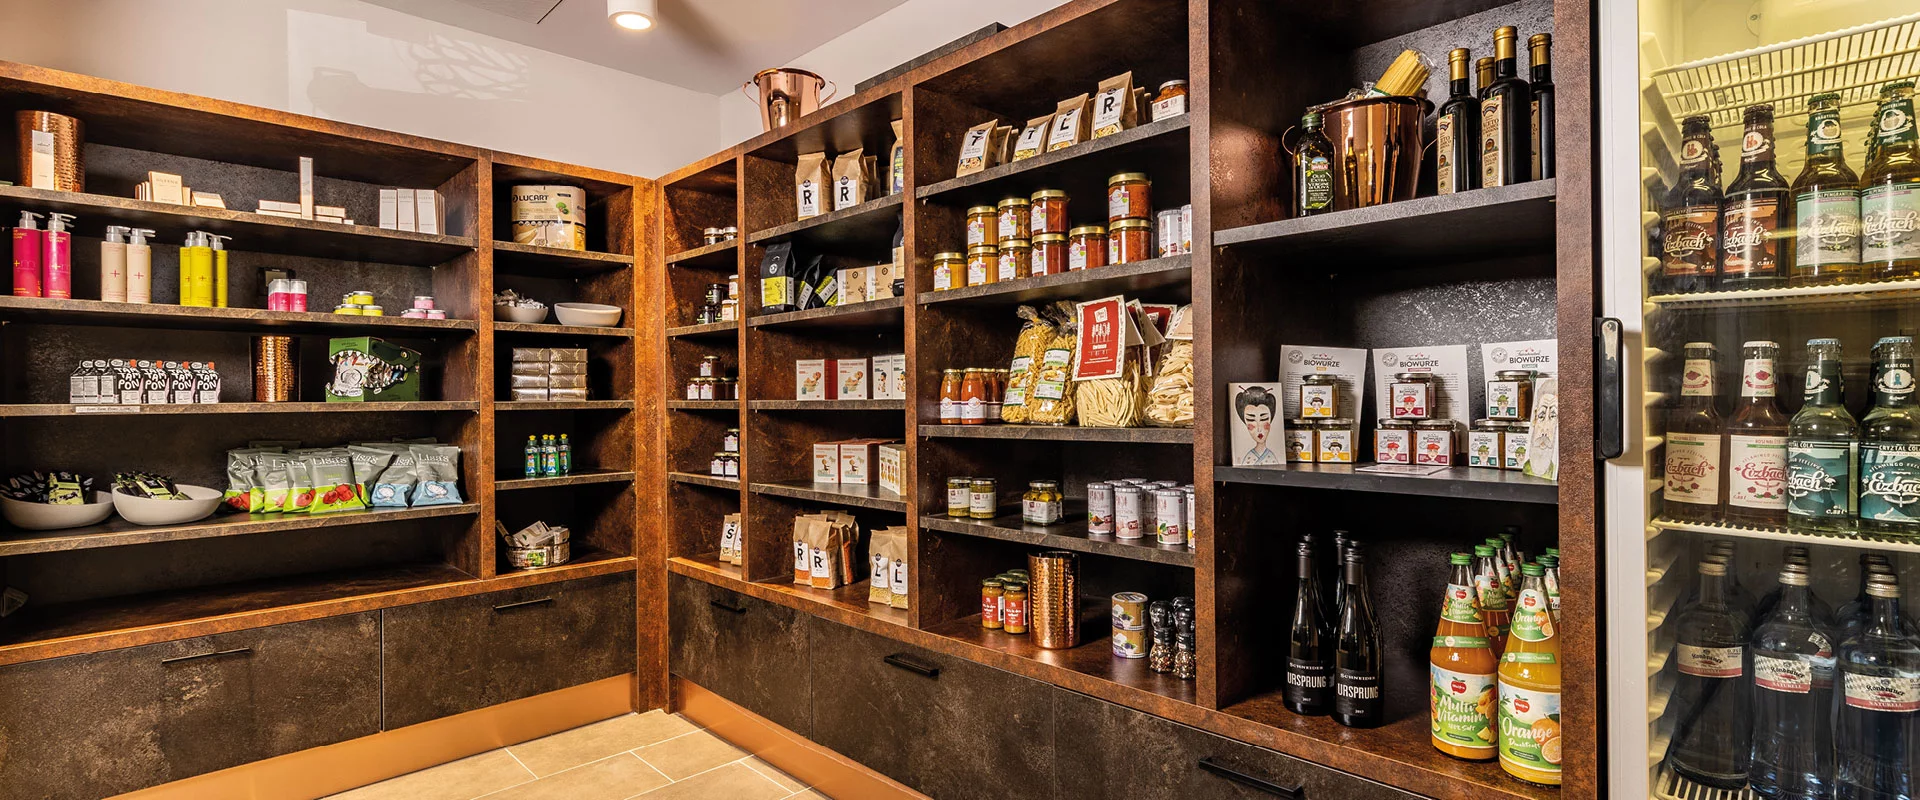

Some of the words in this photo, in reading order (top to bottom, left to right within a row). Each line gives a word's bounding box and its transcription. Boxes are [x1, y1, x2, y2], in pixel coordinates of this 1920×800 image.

[1103, 96, 1115, 114] R
[1060, 118, 1069, 131] L
[519, 193, 549, 202] LUCART
[803, 190, 812, 205] R
[840, 187, 849, 202] R
[1664, 231, 1708, 253] Eizbach
[118, 379, 140, 390] PON
[145, 379, 166, 390] PON
[171, 380, 192, 390] PON
[197, 380, 217, 390] PON
[1666, 457, 1709, 478] Eizbach
[726, 528, 735, 540] S
[797, 548, 804, 561] R
[813, 556, 823, 568] R
[895, 569, 903, 583] L
[1515, 611, 1546, 625] Orange
[1289, 662, 1324, 670] SCHNEIDER
[1287, 671, 1327, 688] URSPRUNG
[1340, 673, 1376, 681] SCHNEIDER
[1337, 683, 1379, 700] URSPRUNG
[1437, 707, 1484, 723] Vitamin
[1503, 716, 1553, 742] Orange
